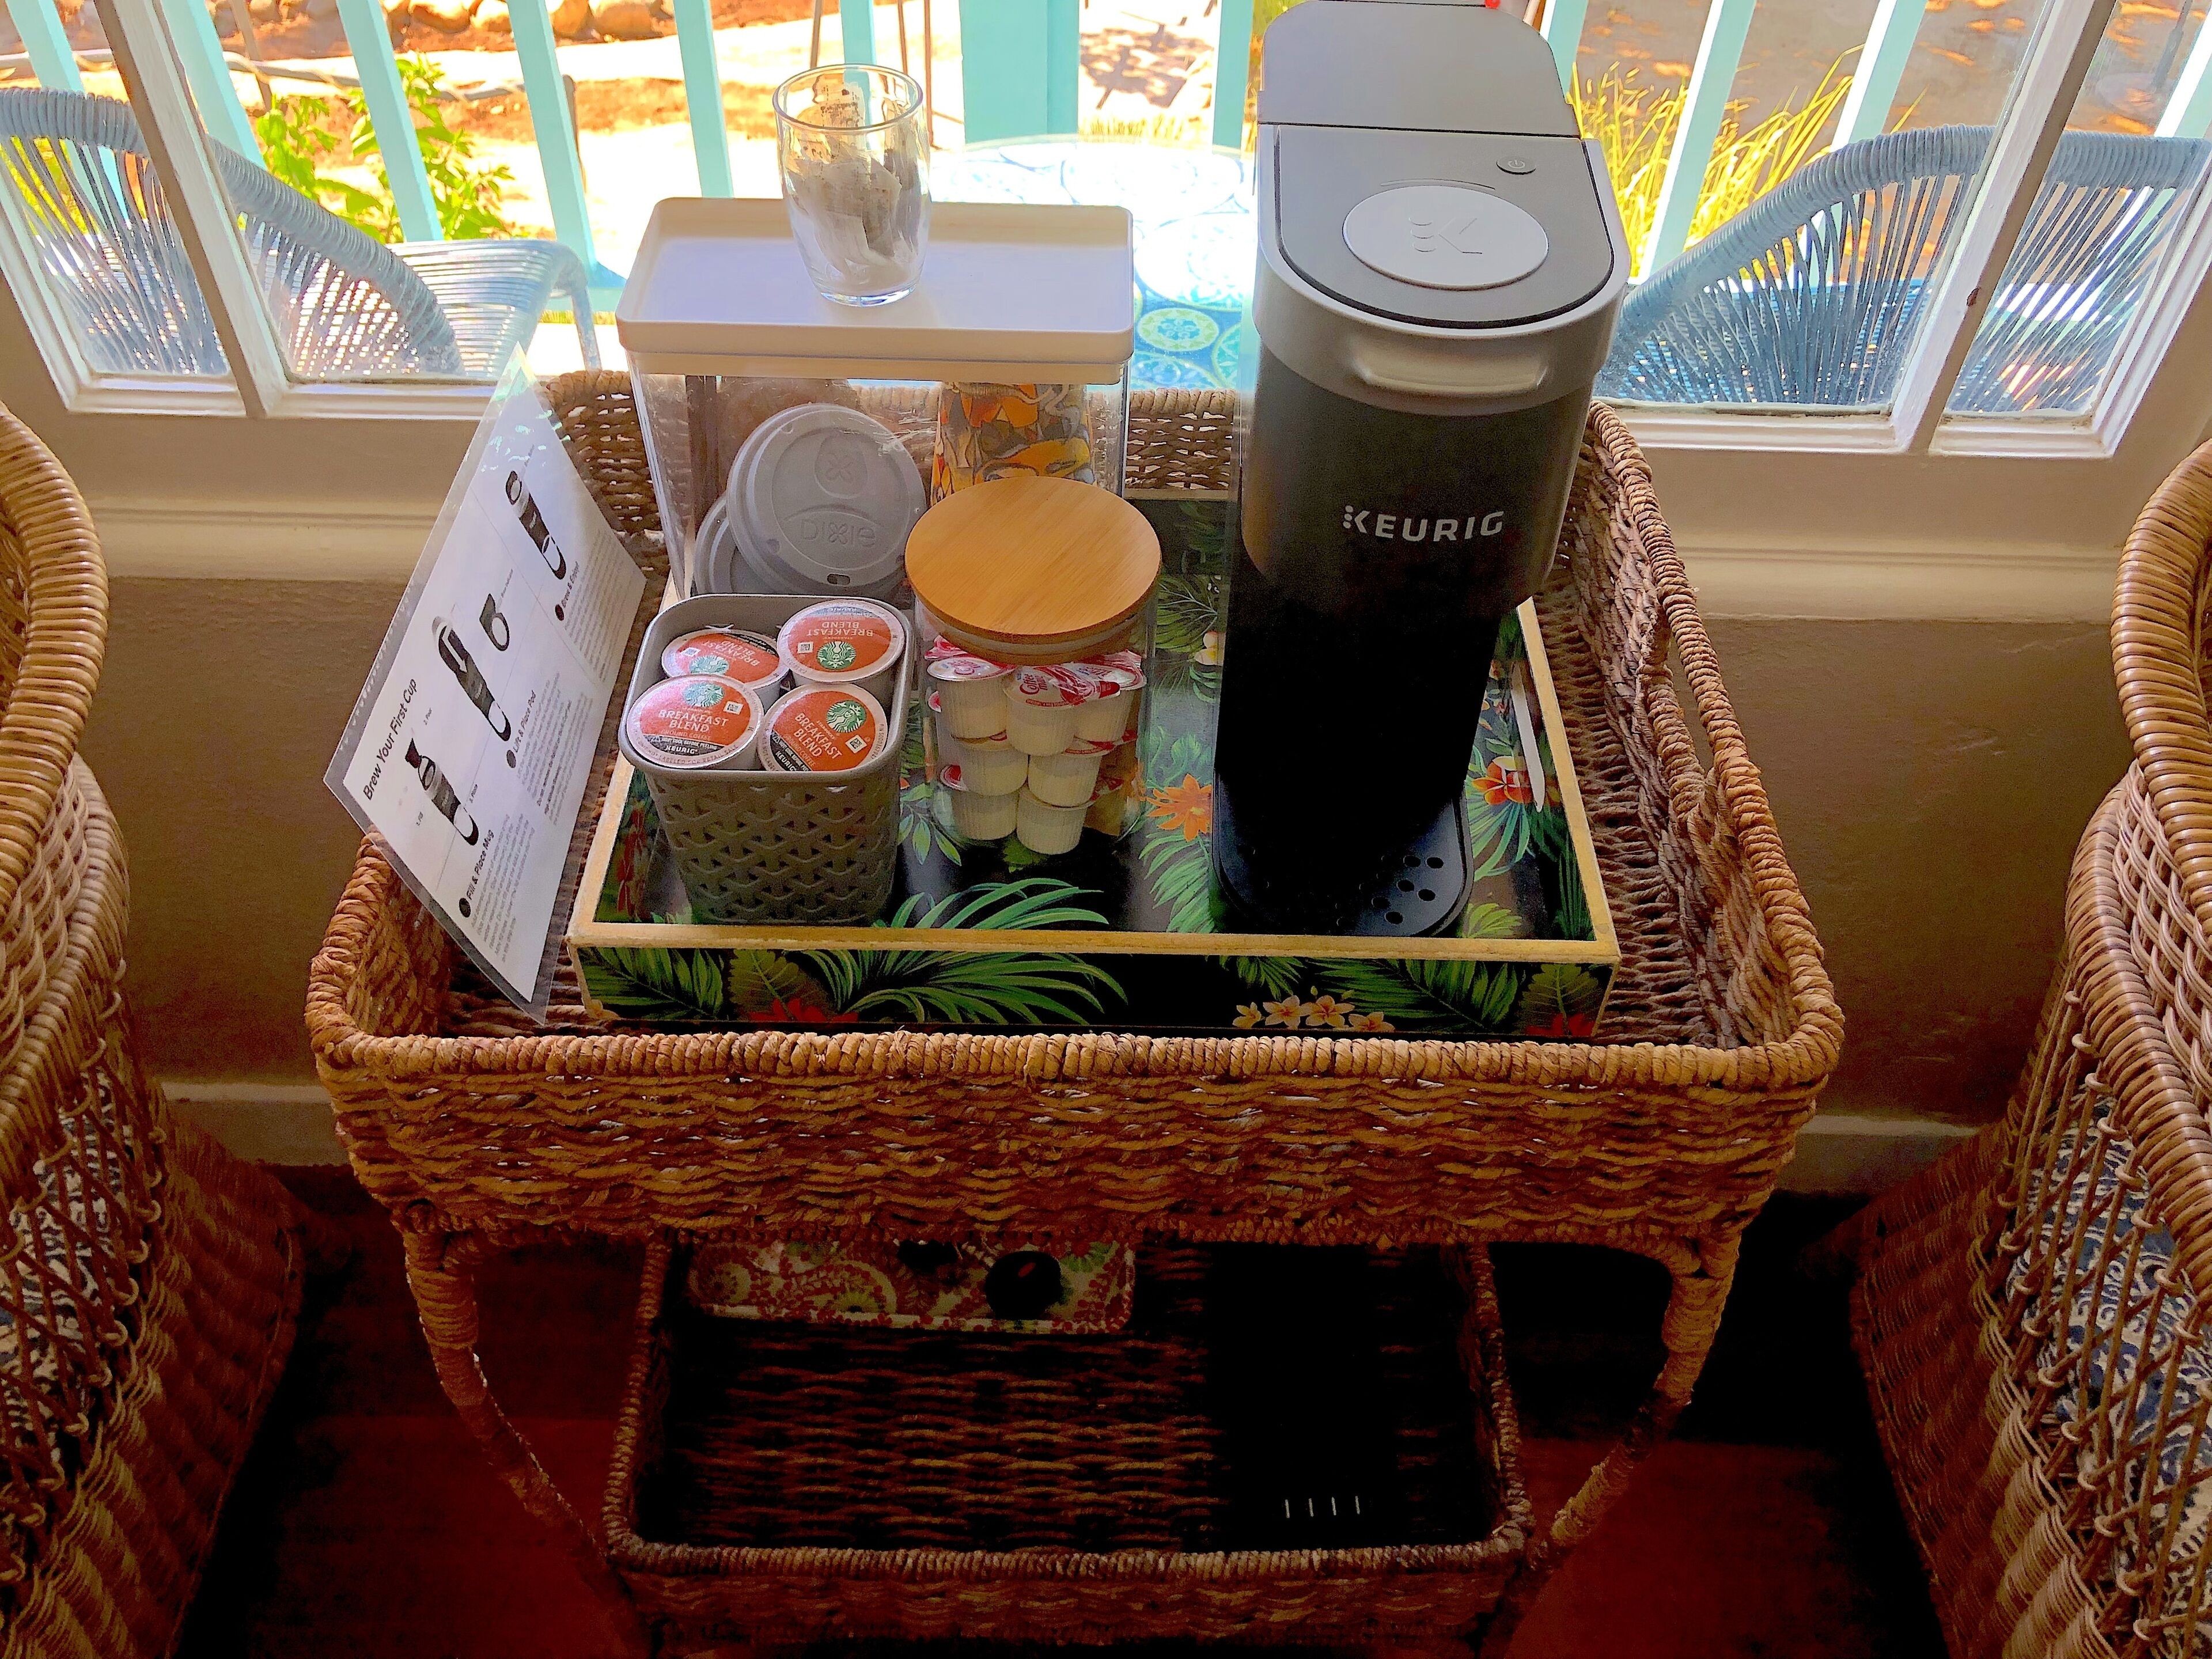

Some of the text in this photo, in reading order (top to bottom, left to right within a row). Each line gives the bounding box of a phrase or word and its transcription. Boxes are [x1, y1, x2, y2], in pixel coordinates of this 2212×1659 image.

[1343, 505, 1505, 542] KEURIG
[806, 628, 874, 637] BREAKFAST
[702, 641, 760, 667] BREAKFAST
[721, 640, 756, 656] BLEND
[513, 736, 521, 753] Lift
[521, 707, 531, 730] Place
[528, 690, 536, 708] Pod
[658, 710, 729, 727] BREAKFAST
[669, 719, 710, 733] BLEND
[363, 678, 418, 801] Brew Your First Cup
[793, 729, 823, 757] BLEND
[794, 712, 843, 759] BREAKFAST
[799, 748, 817, 767] COFFEE
[465, 883, 476, 900] Fill
[474, 849, 487, 877] Place
[482, 829, 494, 852] Mug
